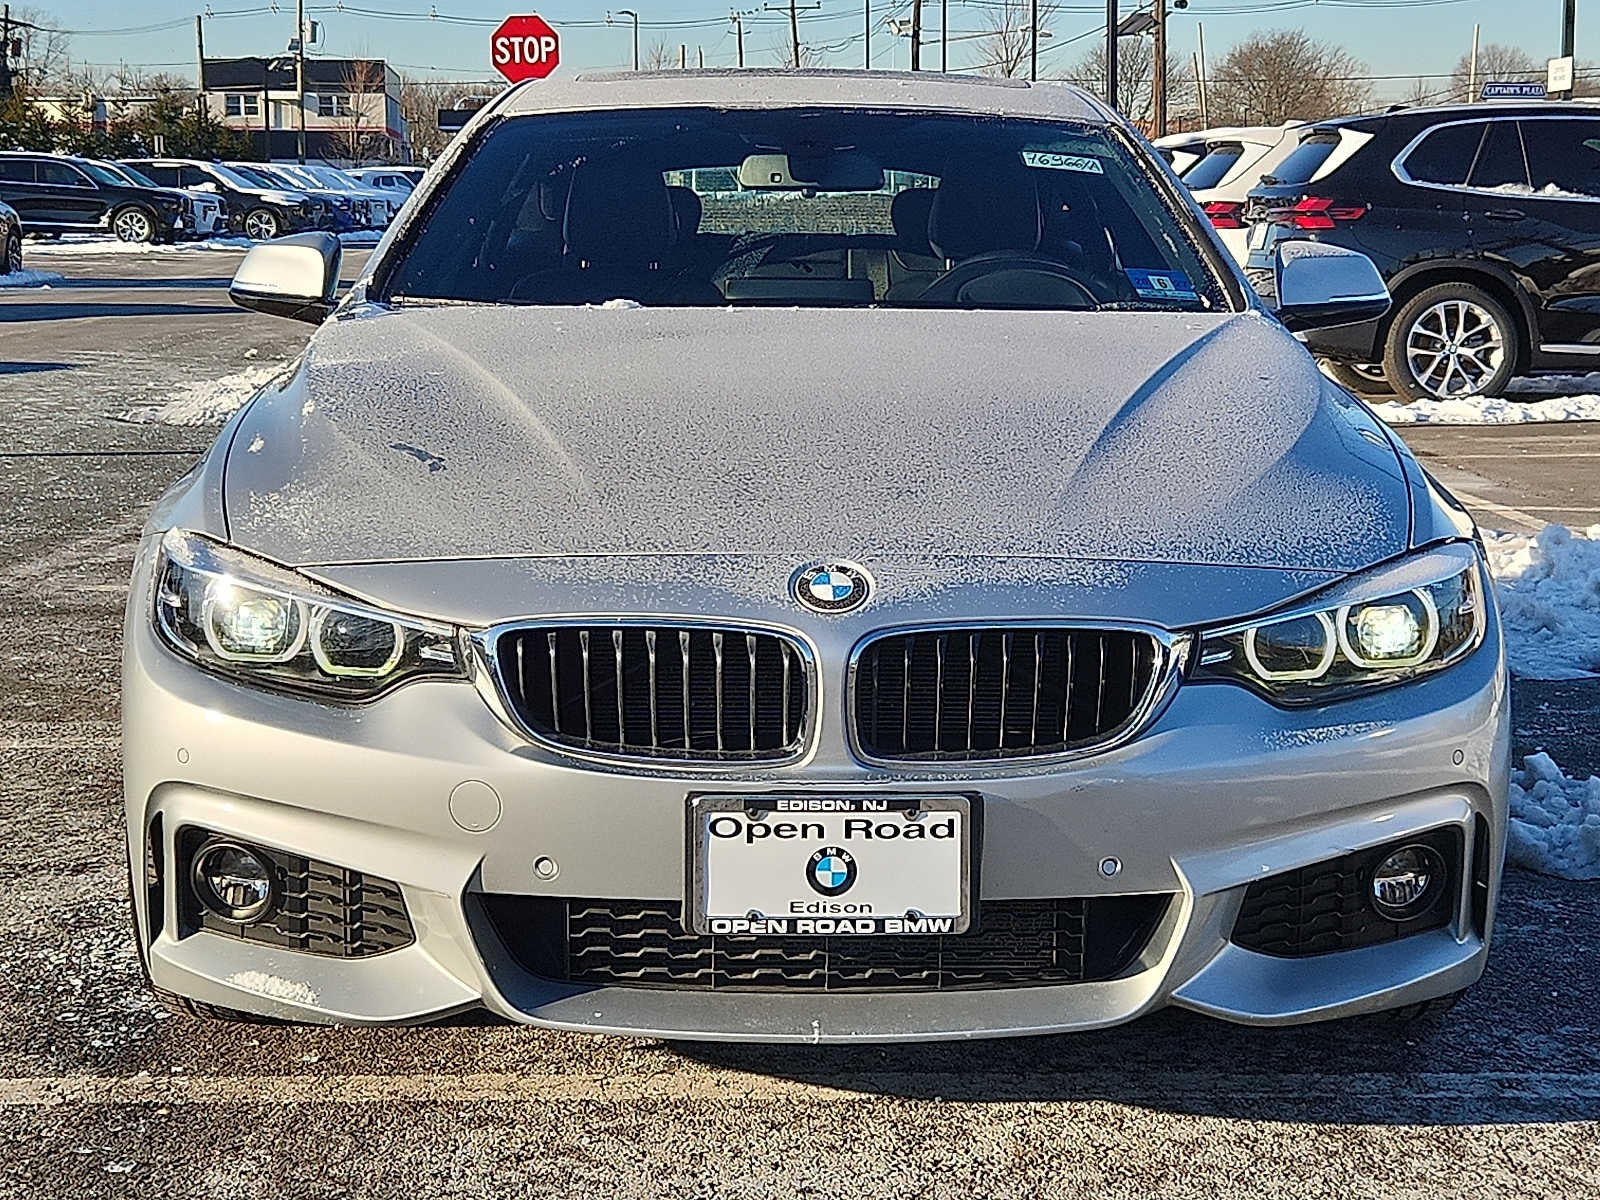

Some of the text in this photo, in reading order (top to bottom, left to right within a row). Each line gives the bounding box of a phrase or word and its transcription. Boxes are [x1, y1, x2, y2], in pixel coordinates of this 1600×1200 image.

[495, 36, 556, 64] STOP
[1522, 87, 1544, 96] PLAZA
[1157, 278, 1168, 289] 6
[802, 563, 861, 579] BMW
[776, 800, 888, 812] EDISON, NJ
[708, 817, 955, 844] Open Road
[813, 847, 852, 862] BMW
[789, 901, 873, 914] Edison
[711, 919, 952, 934] OPEN ROAD BMW
